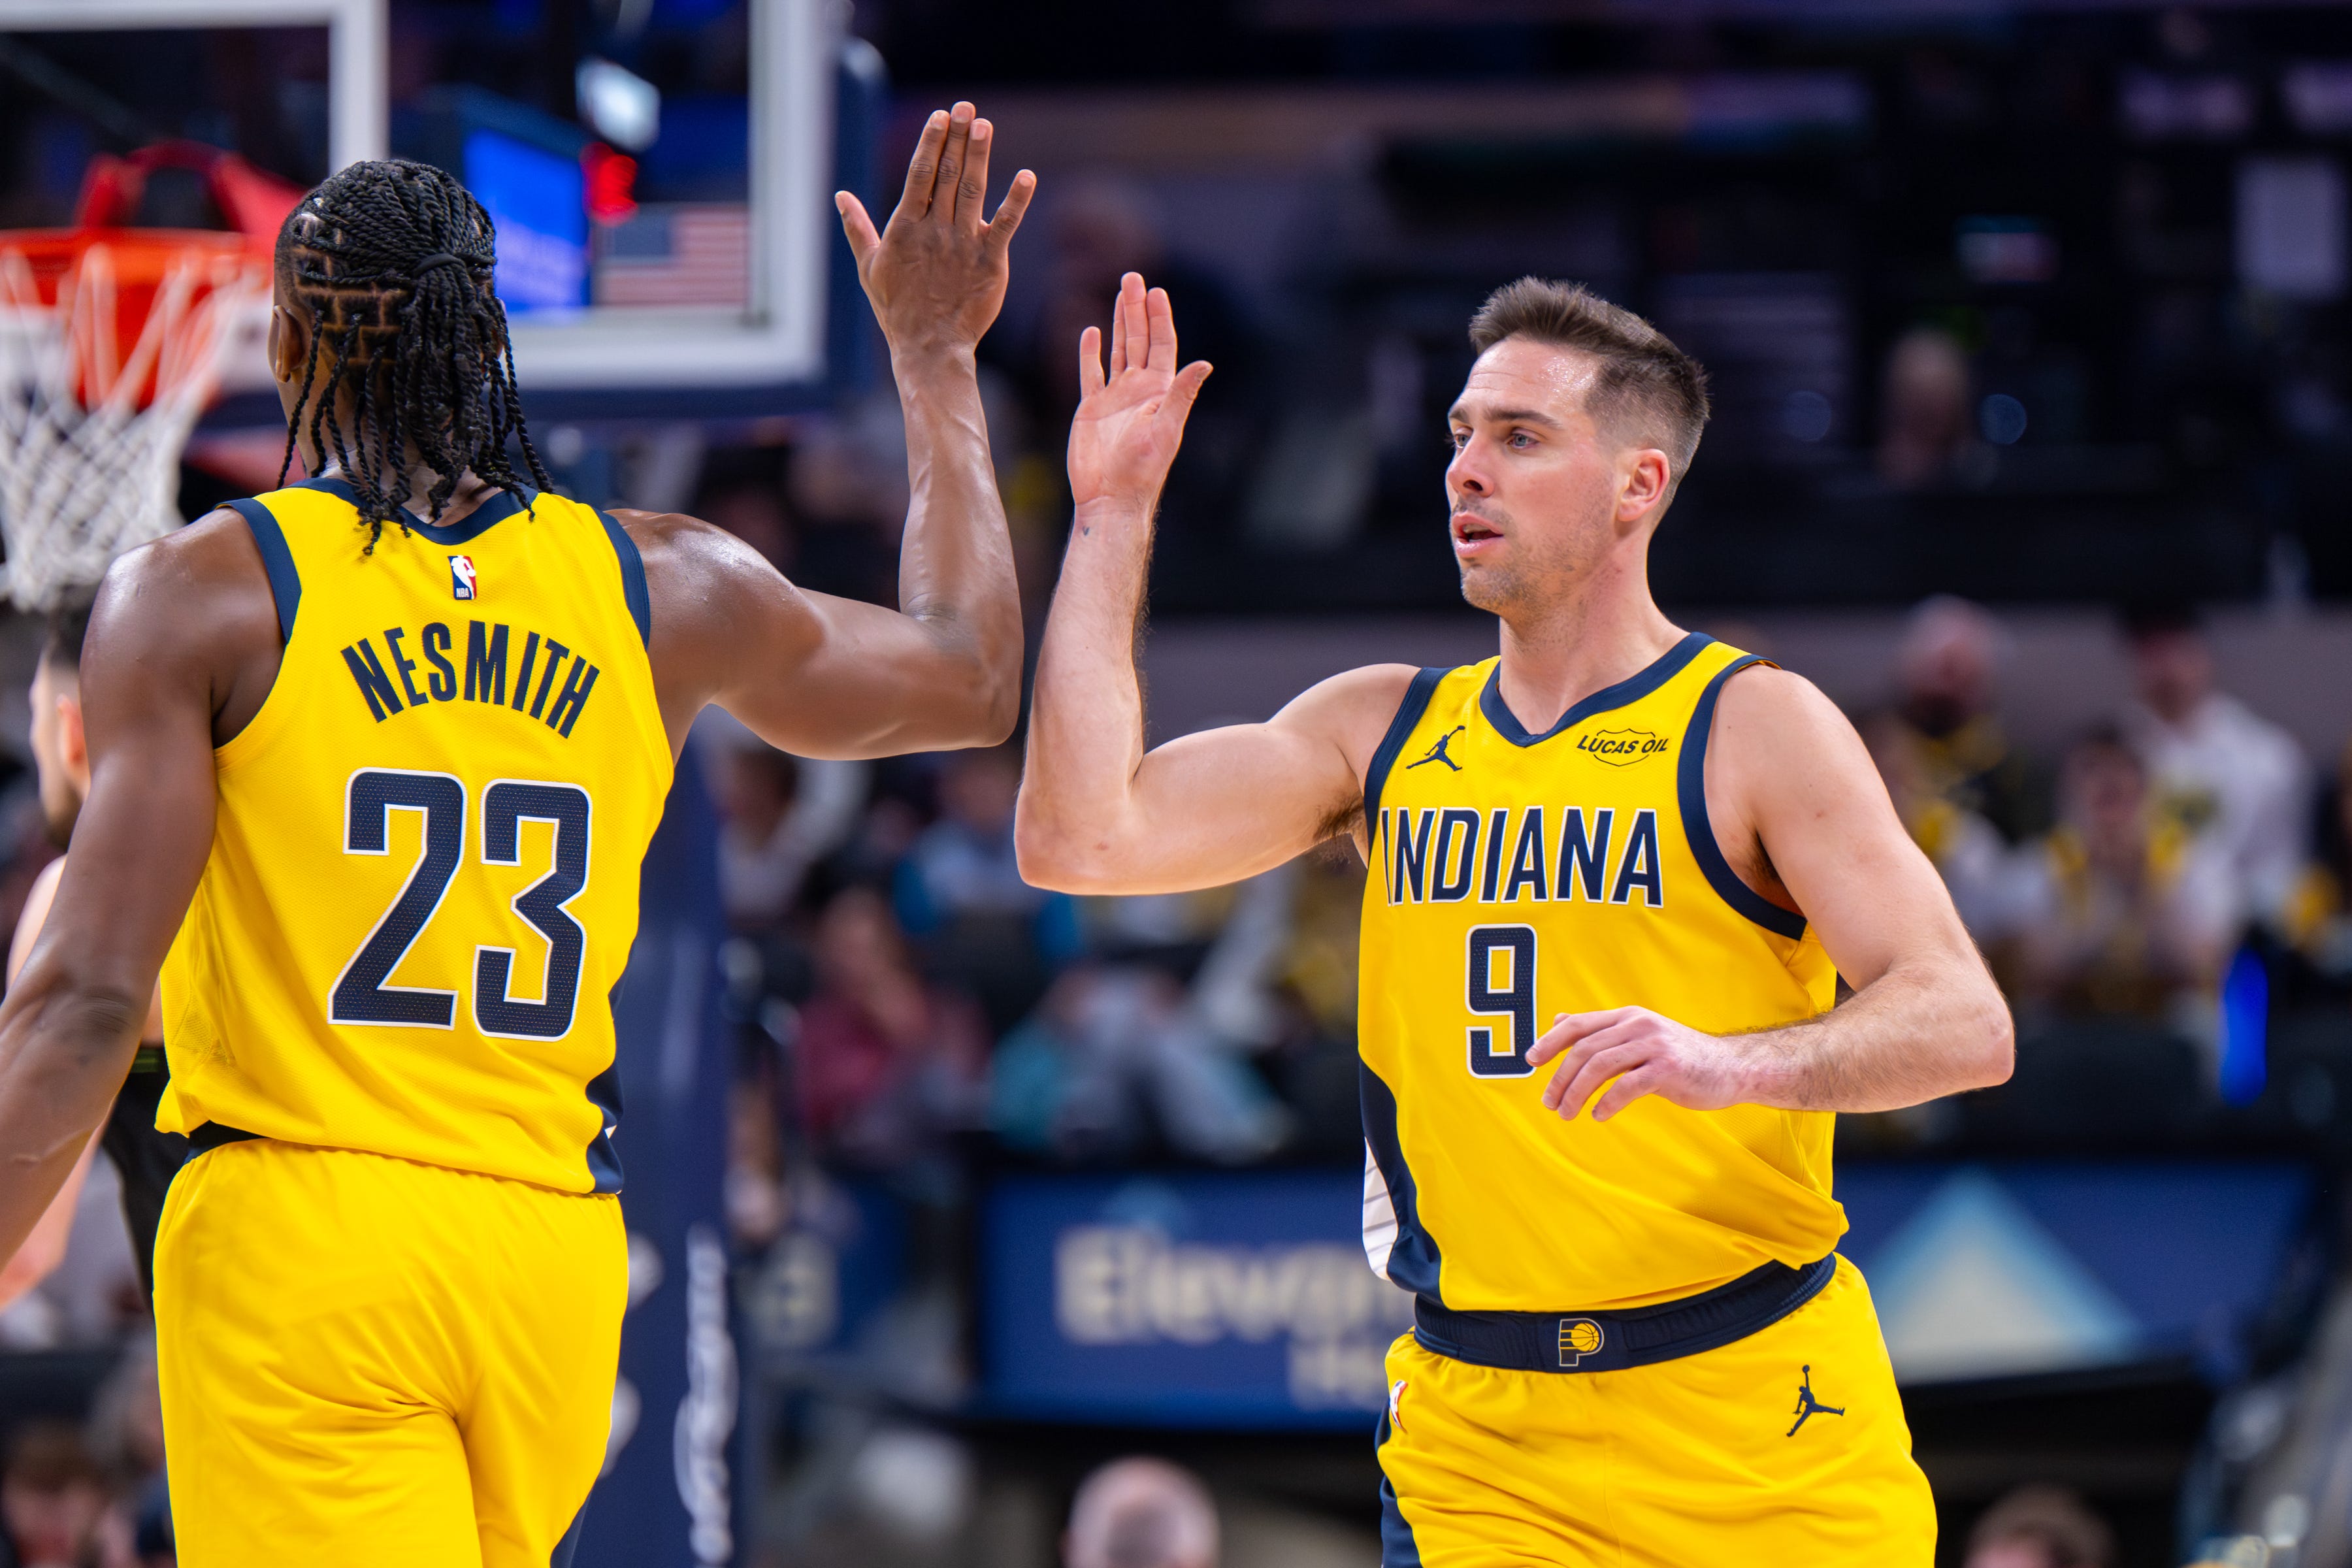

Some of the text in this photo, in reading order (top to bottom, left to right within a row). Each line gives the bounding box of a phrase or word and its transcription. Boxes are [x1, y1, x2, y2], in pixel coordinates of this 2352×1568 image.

[456, 587, 470, 598] NBA
[340, 619, 600, 739] NESMITH
[1576, 735, 1669, 754] LUCAS OIL
[327, 766, 593, 1042] 23
[1380, 805, 1664, 909] INDIANA
[1465, 923, 1538, 1079] 9
